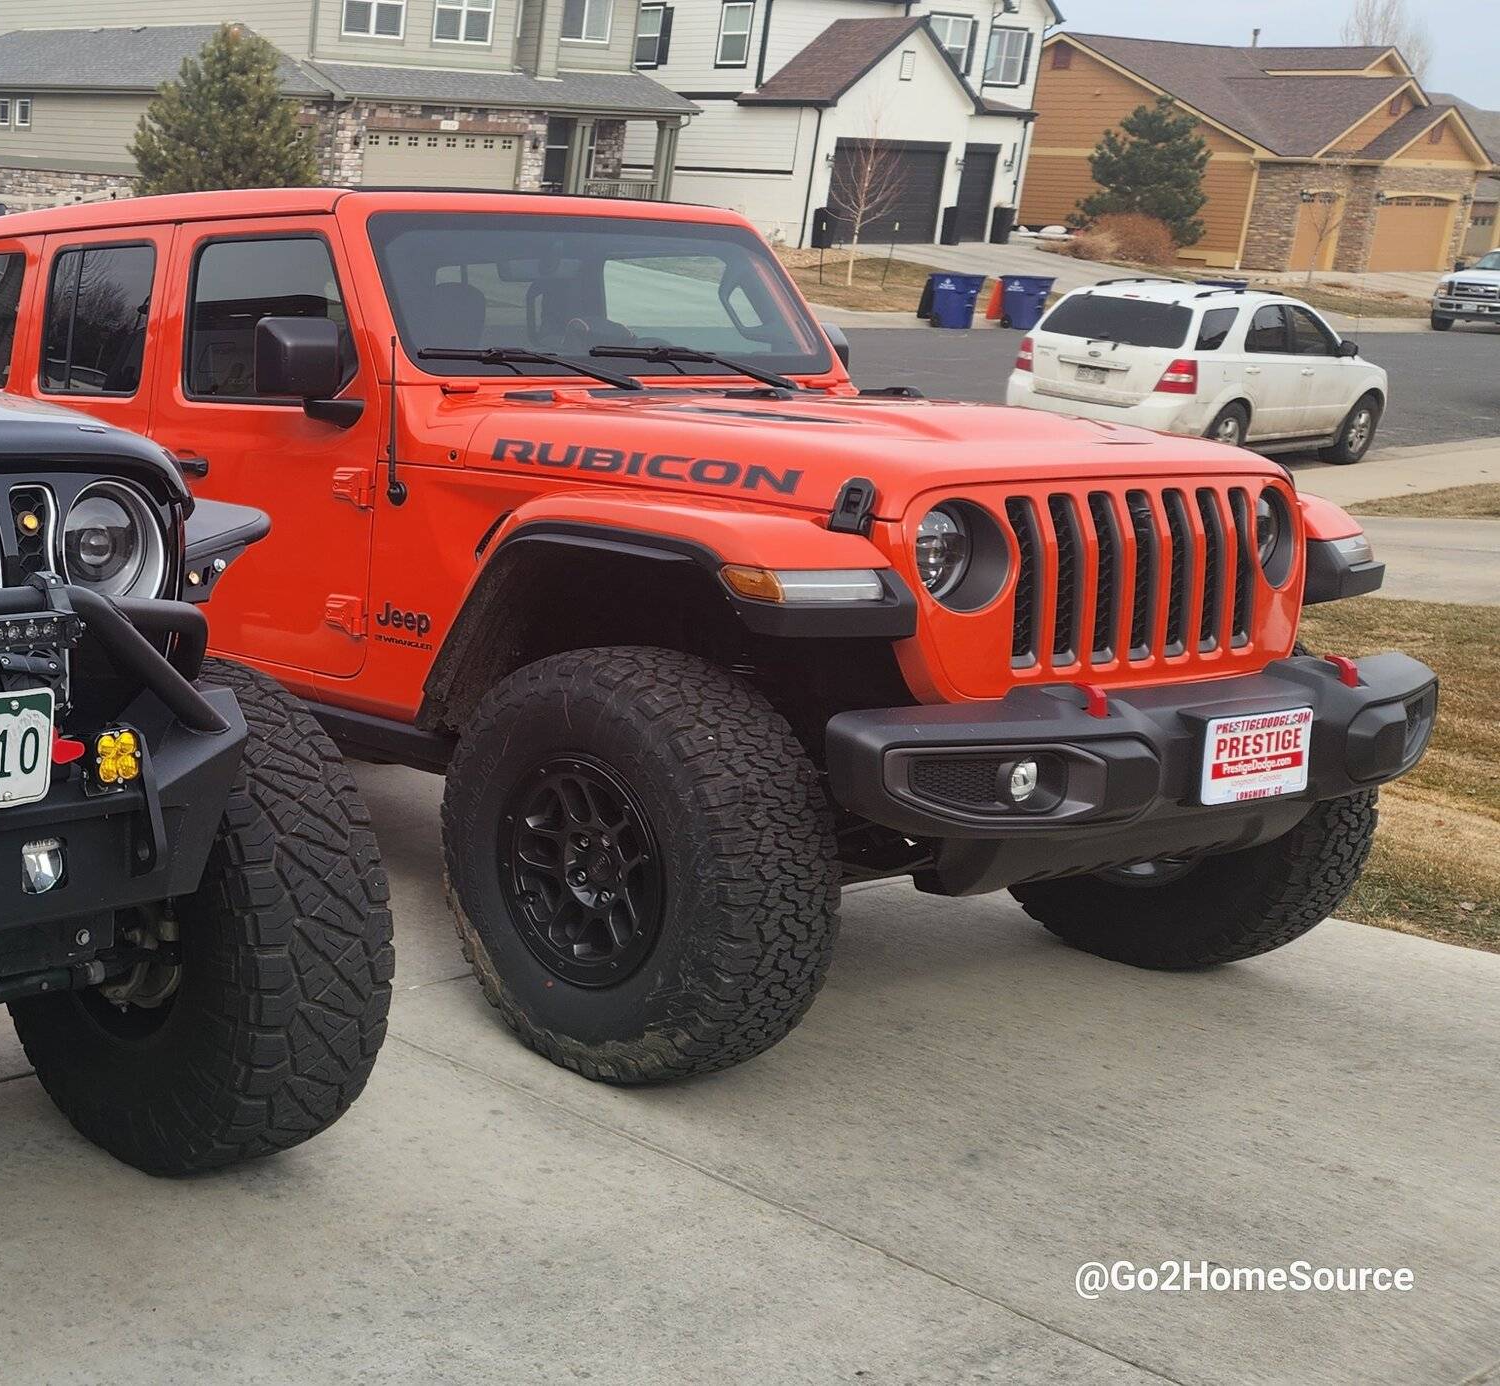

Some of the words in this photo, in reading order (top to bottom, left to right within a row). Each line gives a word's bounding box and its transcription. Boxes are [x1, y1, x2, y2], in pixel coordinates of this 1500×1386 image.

[491, 438, 805, 495] RUBICON
[376, 602, 430, 638] Jeep
[382, 635, 432, 651] WRANGLER
[1215, 711, 1311, 735] PRESTIGEDODGE.COM
[1215, 728, 1302, 761] PRESTIGE
[1222, 756, 1291, 775] PrestigeDodge.com
